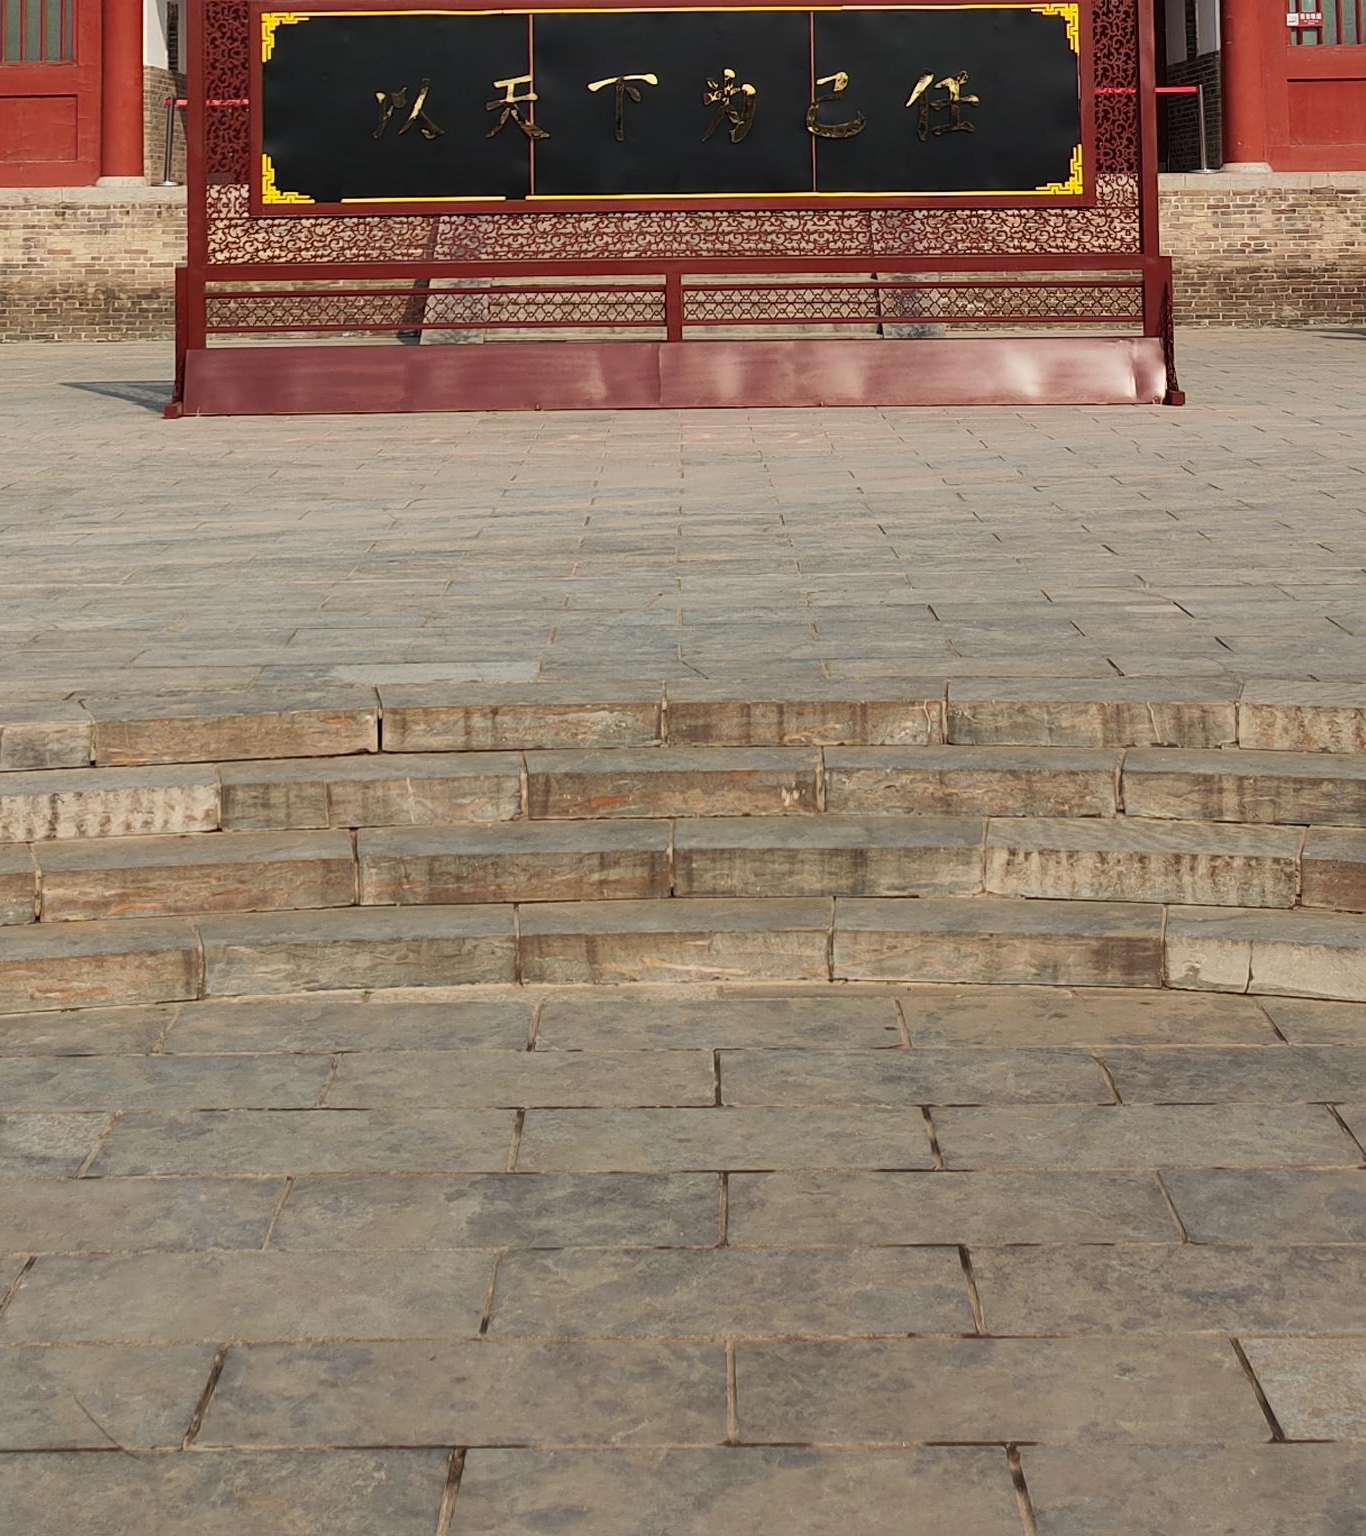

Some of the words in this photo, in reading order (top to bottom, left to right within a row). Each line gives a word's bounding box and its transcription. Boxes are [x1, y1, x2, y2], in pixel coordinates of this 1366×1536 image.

[372, 67, 980, 144] 以天下为己任
